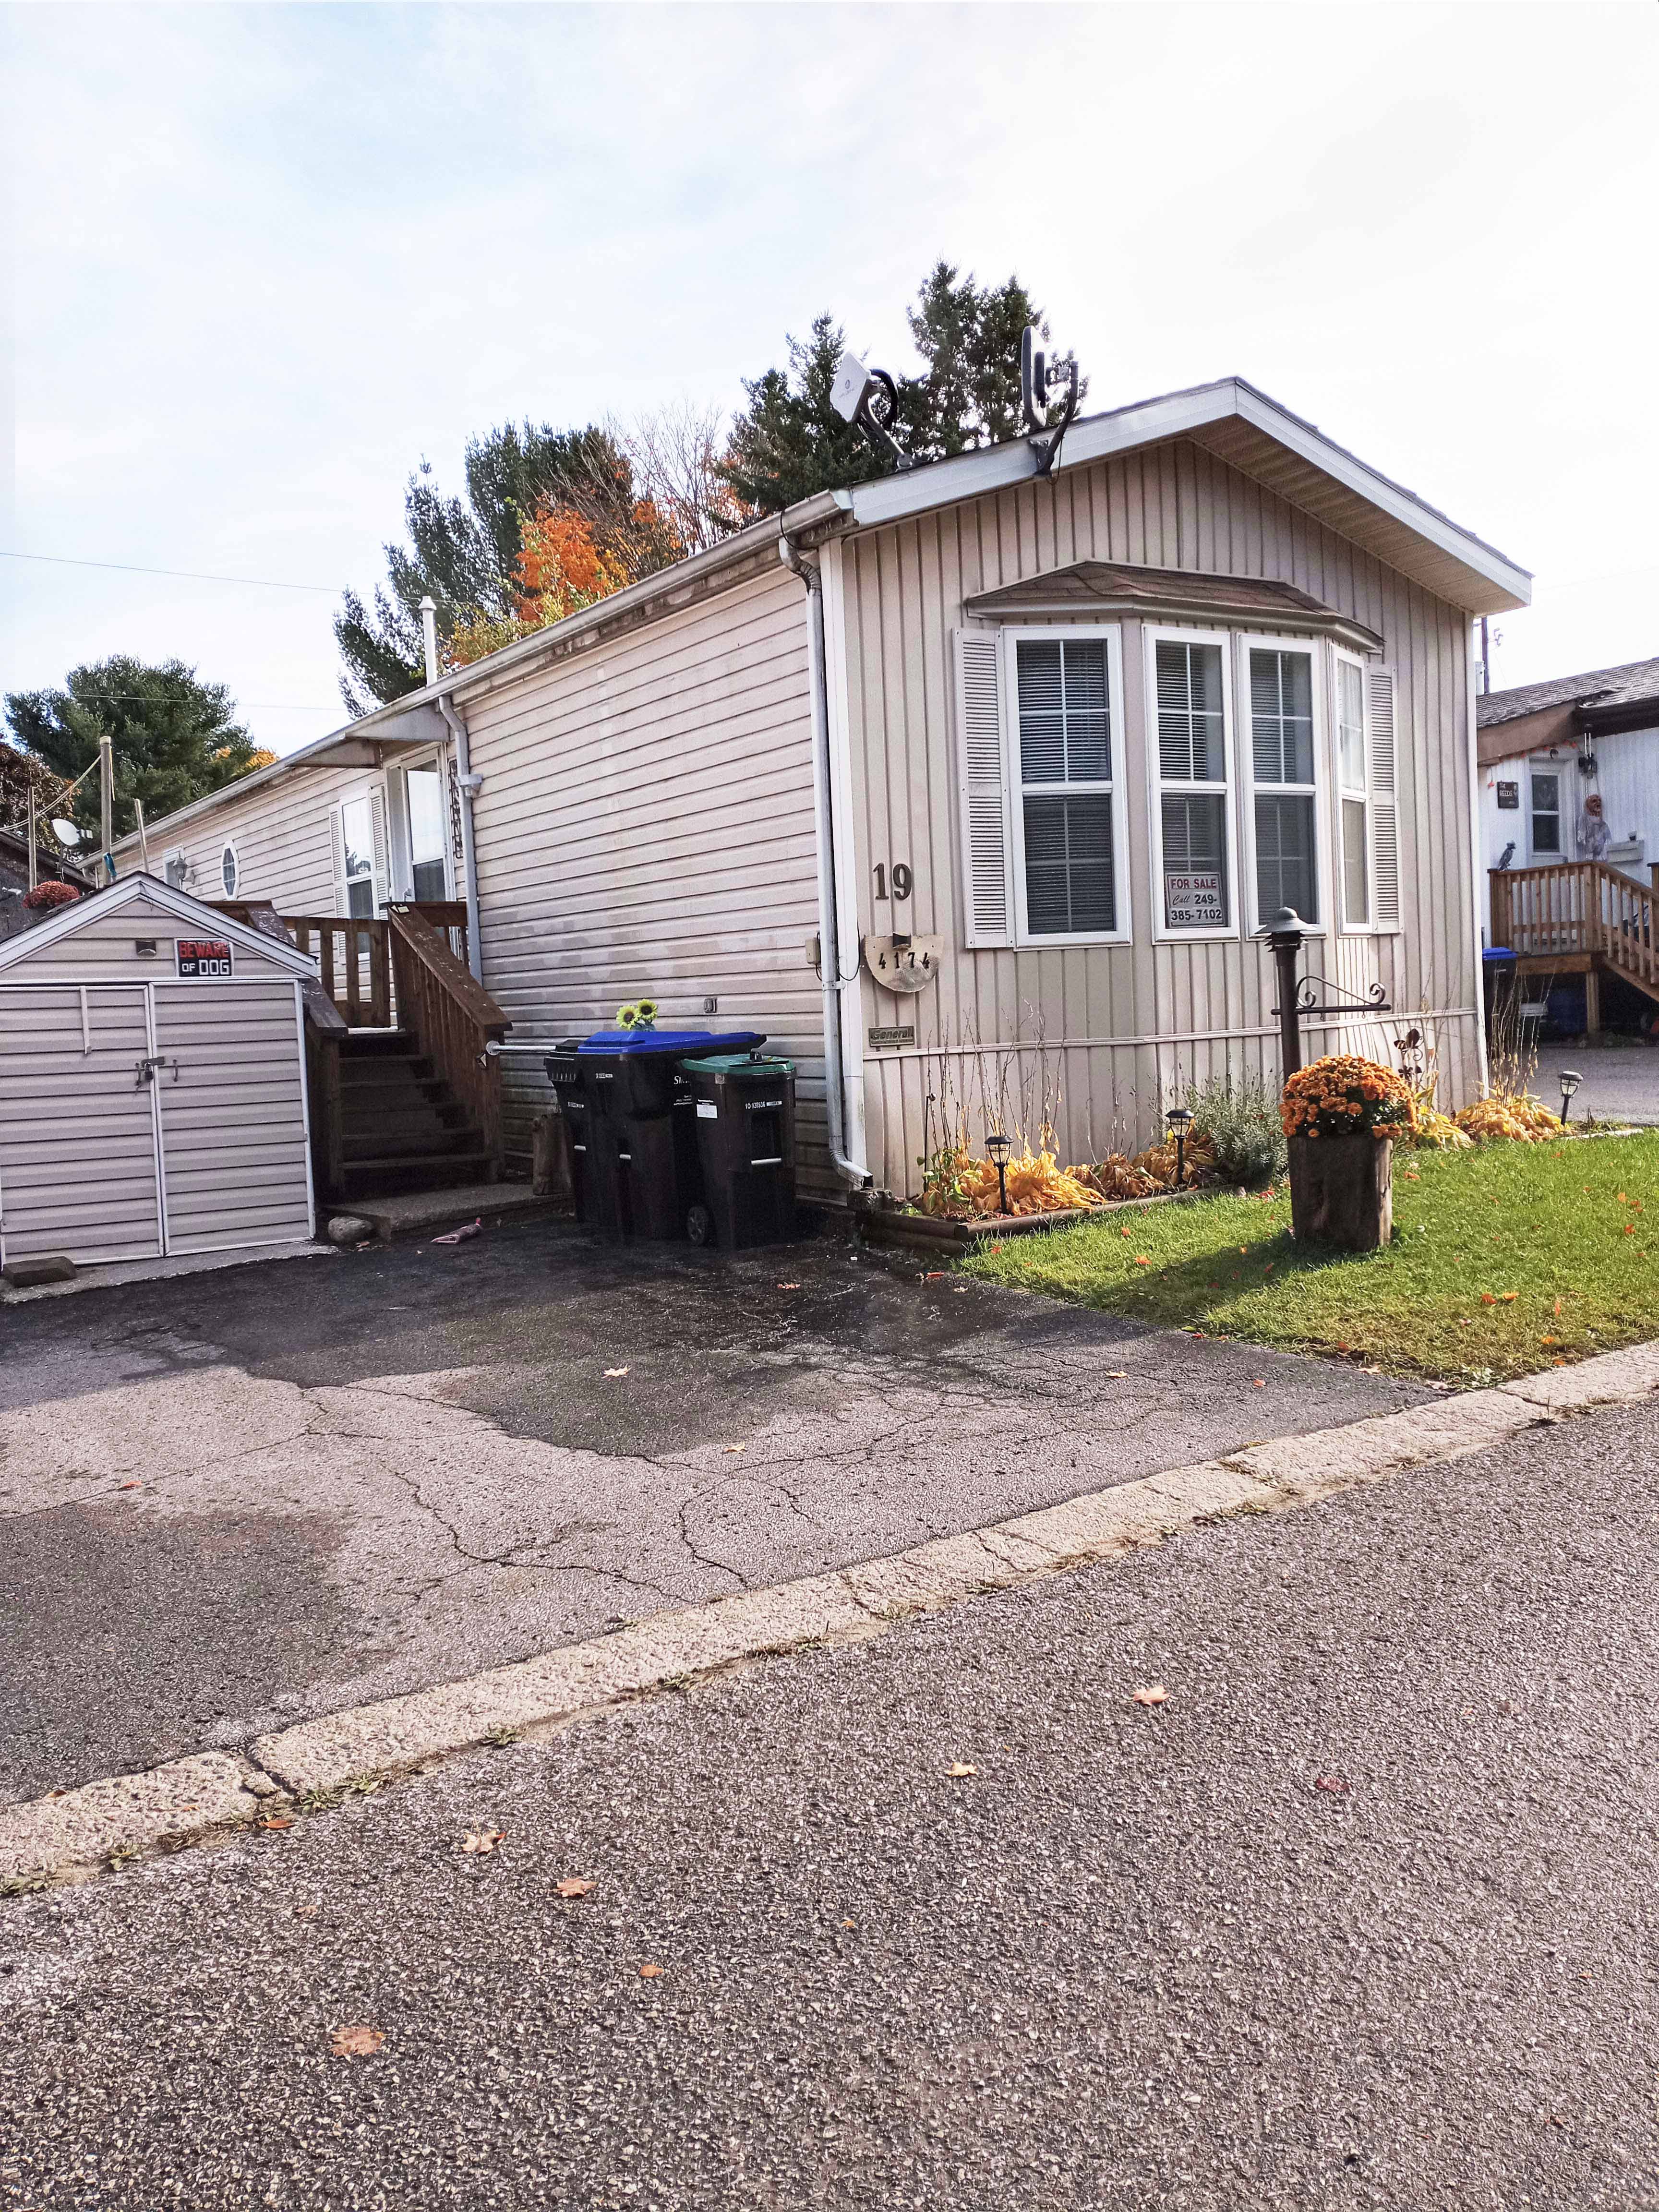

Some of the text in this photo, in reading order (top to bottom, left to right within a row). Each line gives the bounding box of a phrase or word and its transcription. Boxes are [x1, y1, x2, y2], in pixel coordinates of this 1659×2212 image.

[873, 862, 912, 901] 19
[1170, 878, 1217, 889] FOR SALE
[1172, 894, 1217, 905] Call 249-
[179, 941, 230, 958] BEWARE
[181, 959, 229, 975] OF DOG
